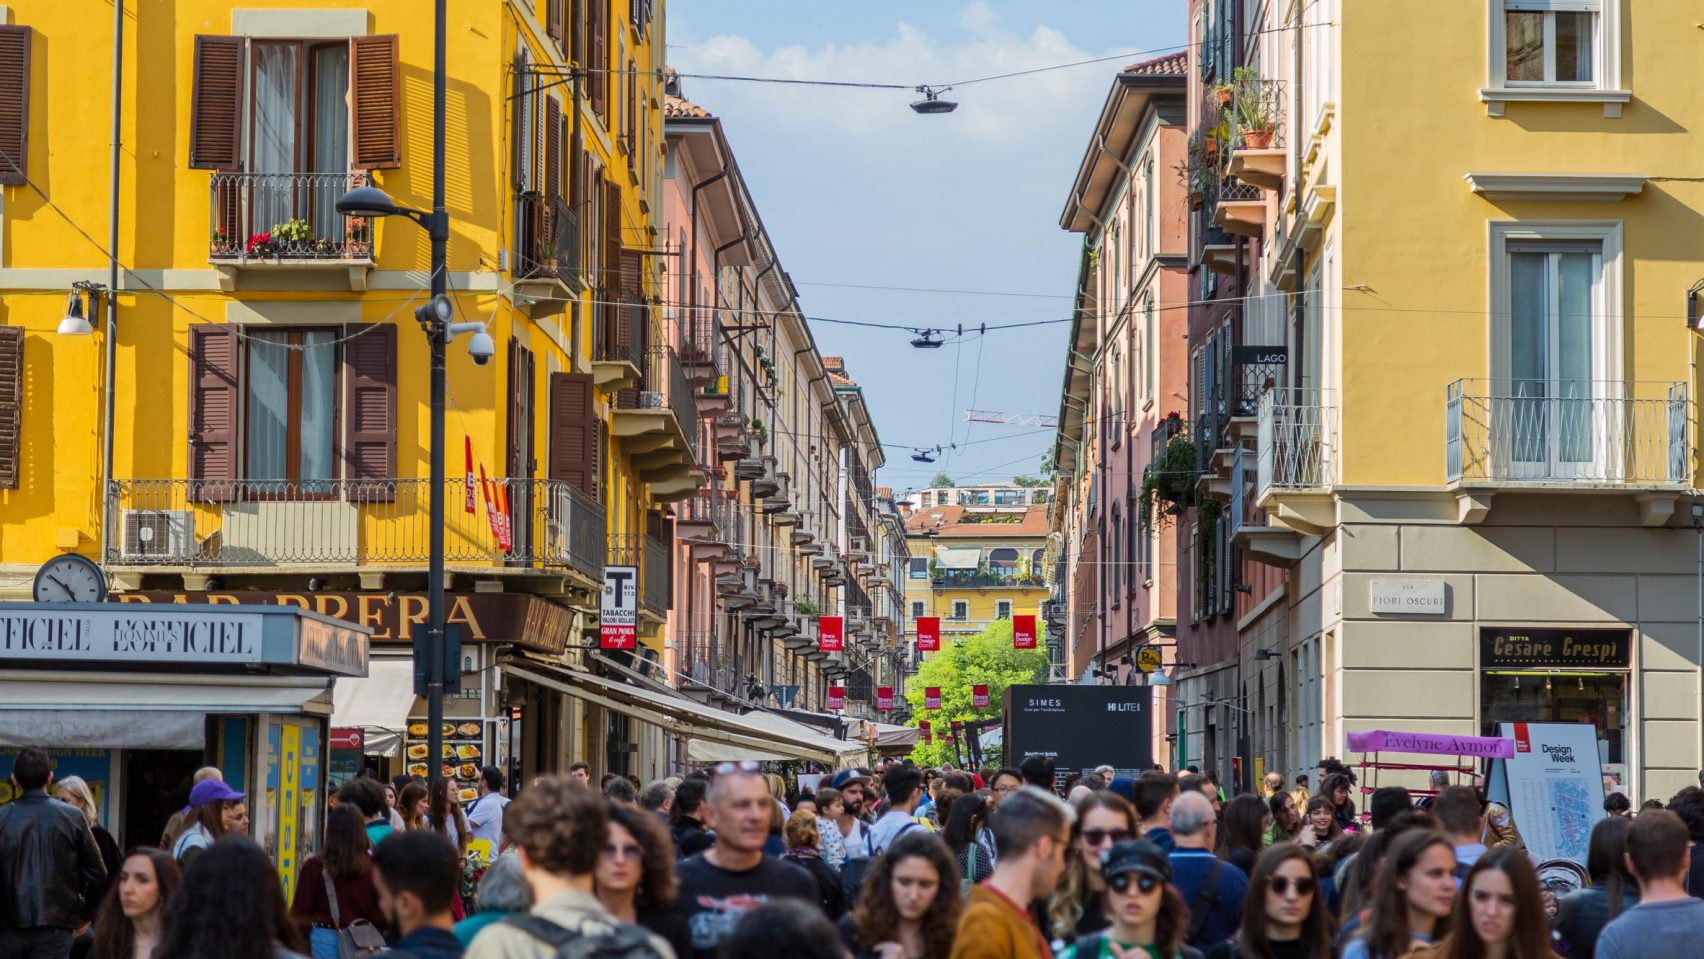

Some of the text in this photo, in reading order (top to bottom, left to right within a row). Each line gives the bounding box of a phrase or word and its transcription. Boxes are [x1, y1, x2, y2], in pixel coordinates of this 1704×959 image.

[1257, 354, 1286, 362] LAGO
[606, 572, 632, 608] T
[1373, 596, 1444, 606] FIORI OSCURI
[0, 618, 90, 650] FICIEL
[1562, 636, 1617, 662] Crespi
[1029, 698, 1061, 706] SIMES
[1108, 702, 1116, 711] HI
[1384, 732, 1442, 752] Evelyne
[1448, 738, 1502, 754] Aymon
[1542, 744, 1572, 755] Design
[1551, 754, 1575, 762] Week
